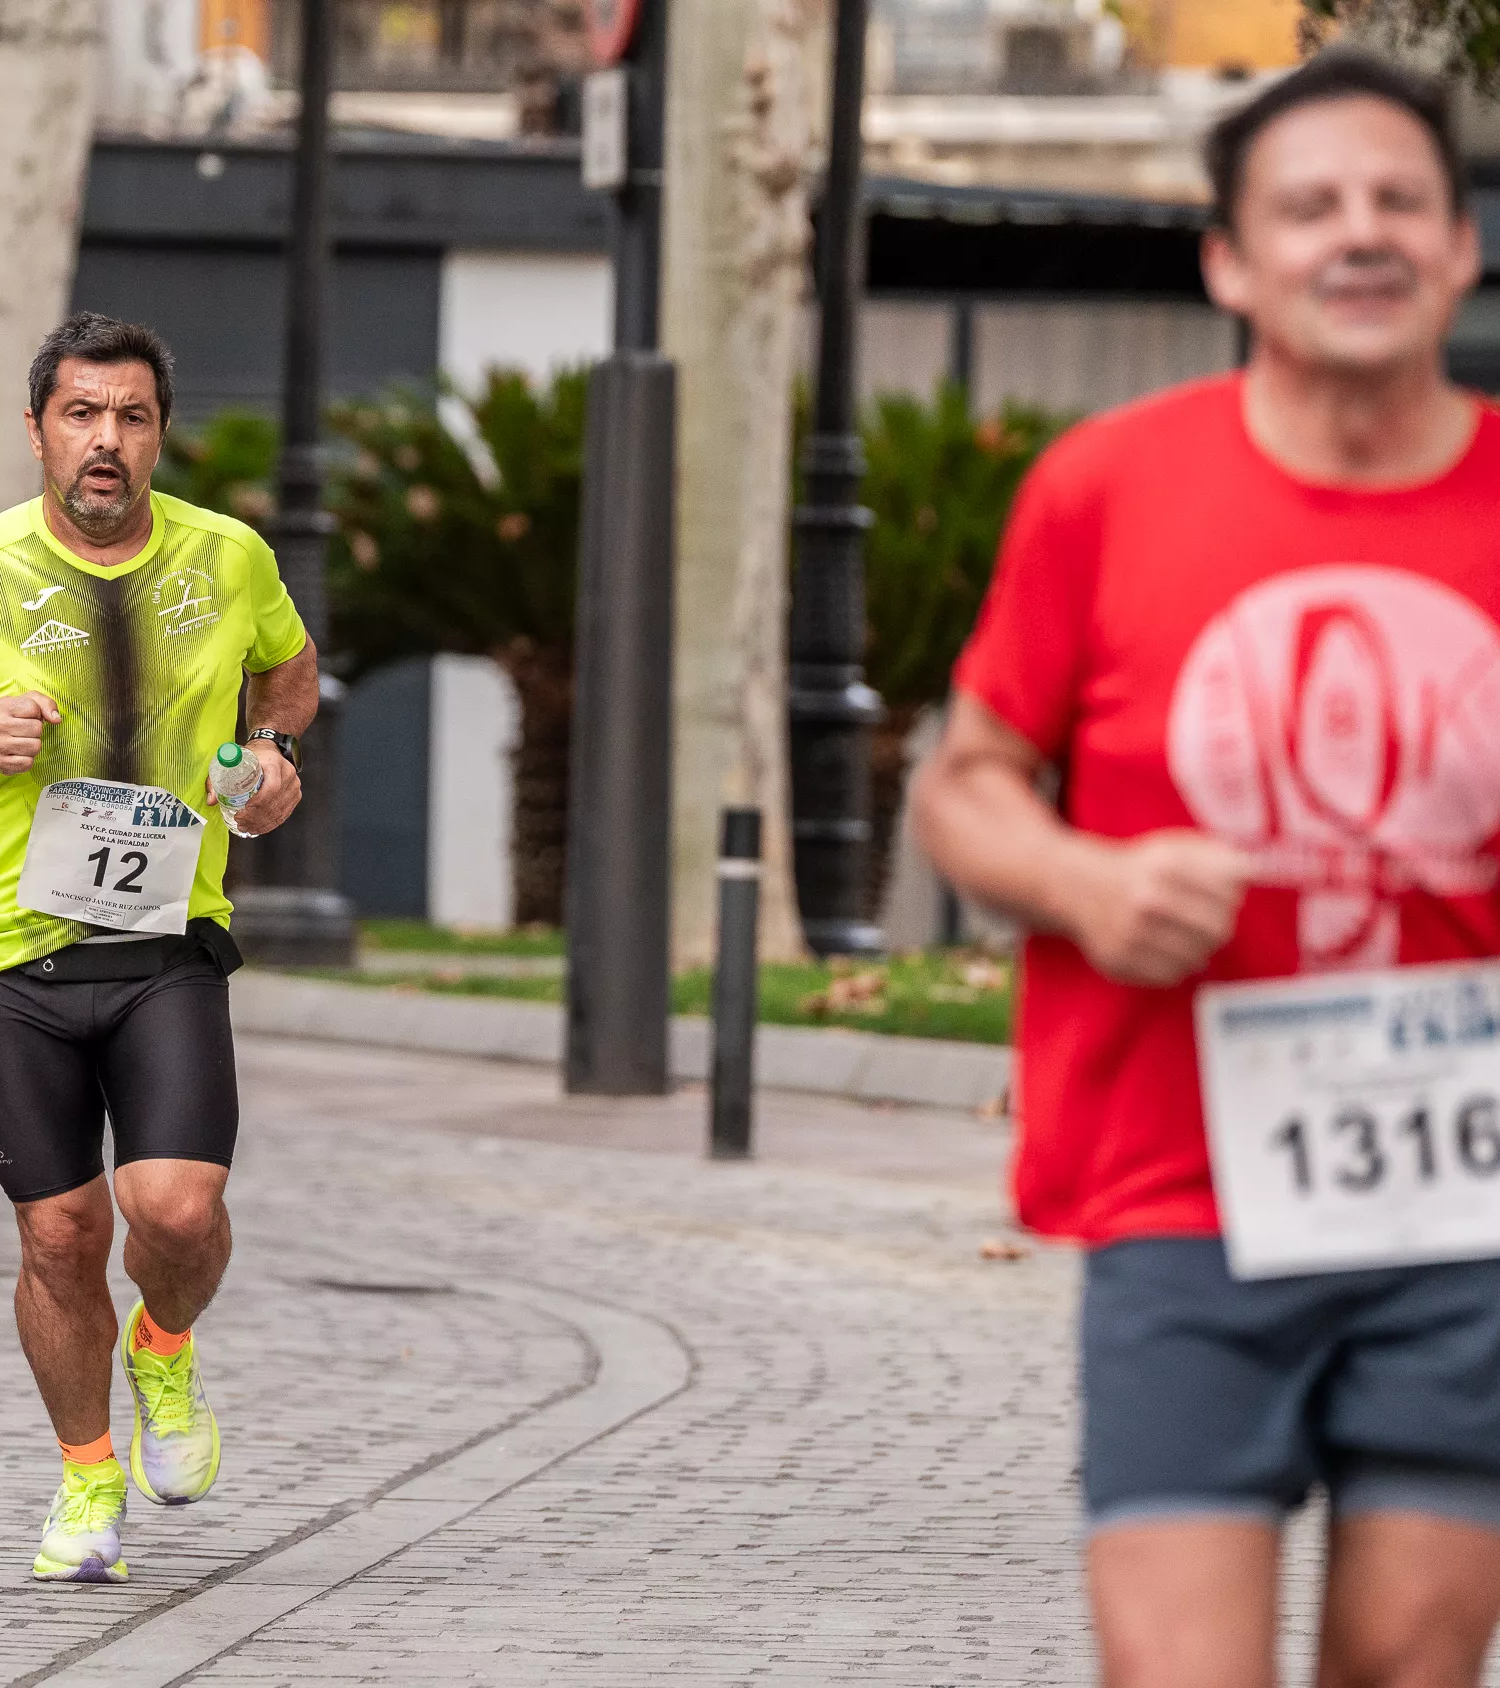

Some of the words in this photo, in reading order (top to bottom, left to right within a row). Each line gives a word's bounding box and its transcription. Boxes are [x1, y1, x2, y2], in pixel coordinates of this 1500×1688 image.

[83, 783, 125, 796] PROVINCIAL
[89, 799, 98, 807] DE
[90, 791, 135, 805] POPULARES
[134, 789, 177, 808] 2024
[80, 823, 95, 831] XXV
[108, 829, 132, 838] CIUDAD
[92, 834, 106, 842] POR
[117, 838, 150, 848] IGUALDAD
[87, 846, 148, 894] 12
[51, 889, 91, 903] FRANCISCO
[92, 898, 118, 909] JAVIER
[118, 903, 133, 911] RUZ
[1266, 1092, 1500, 1198] 1316
